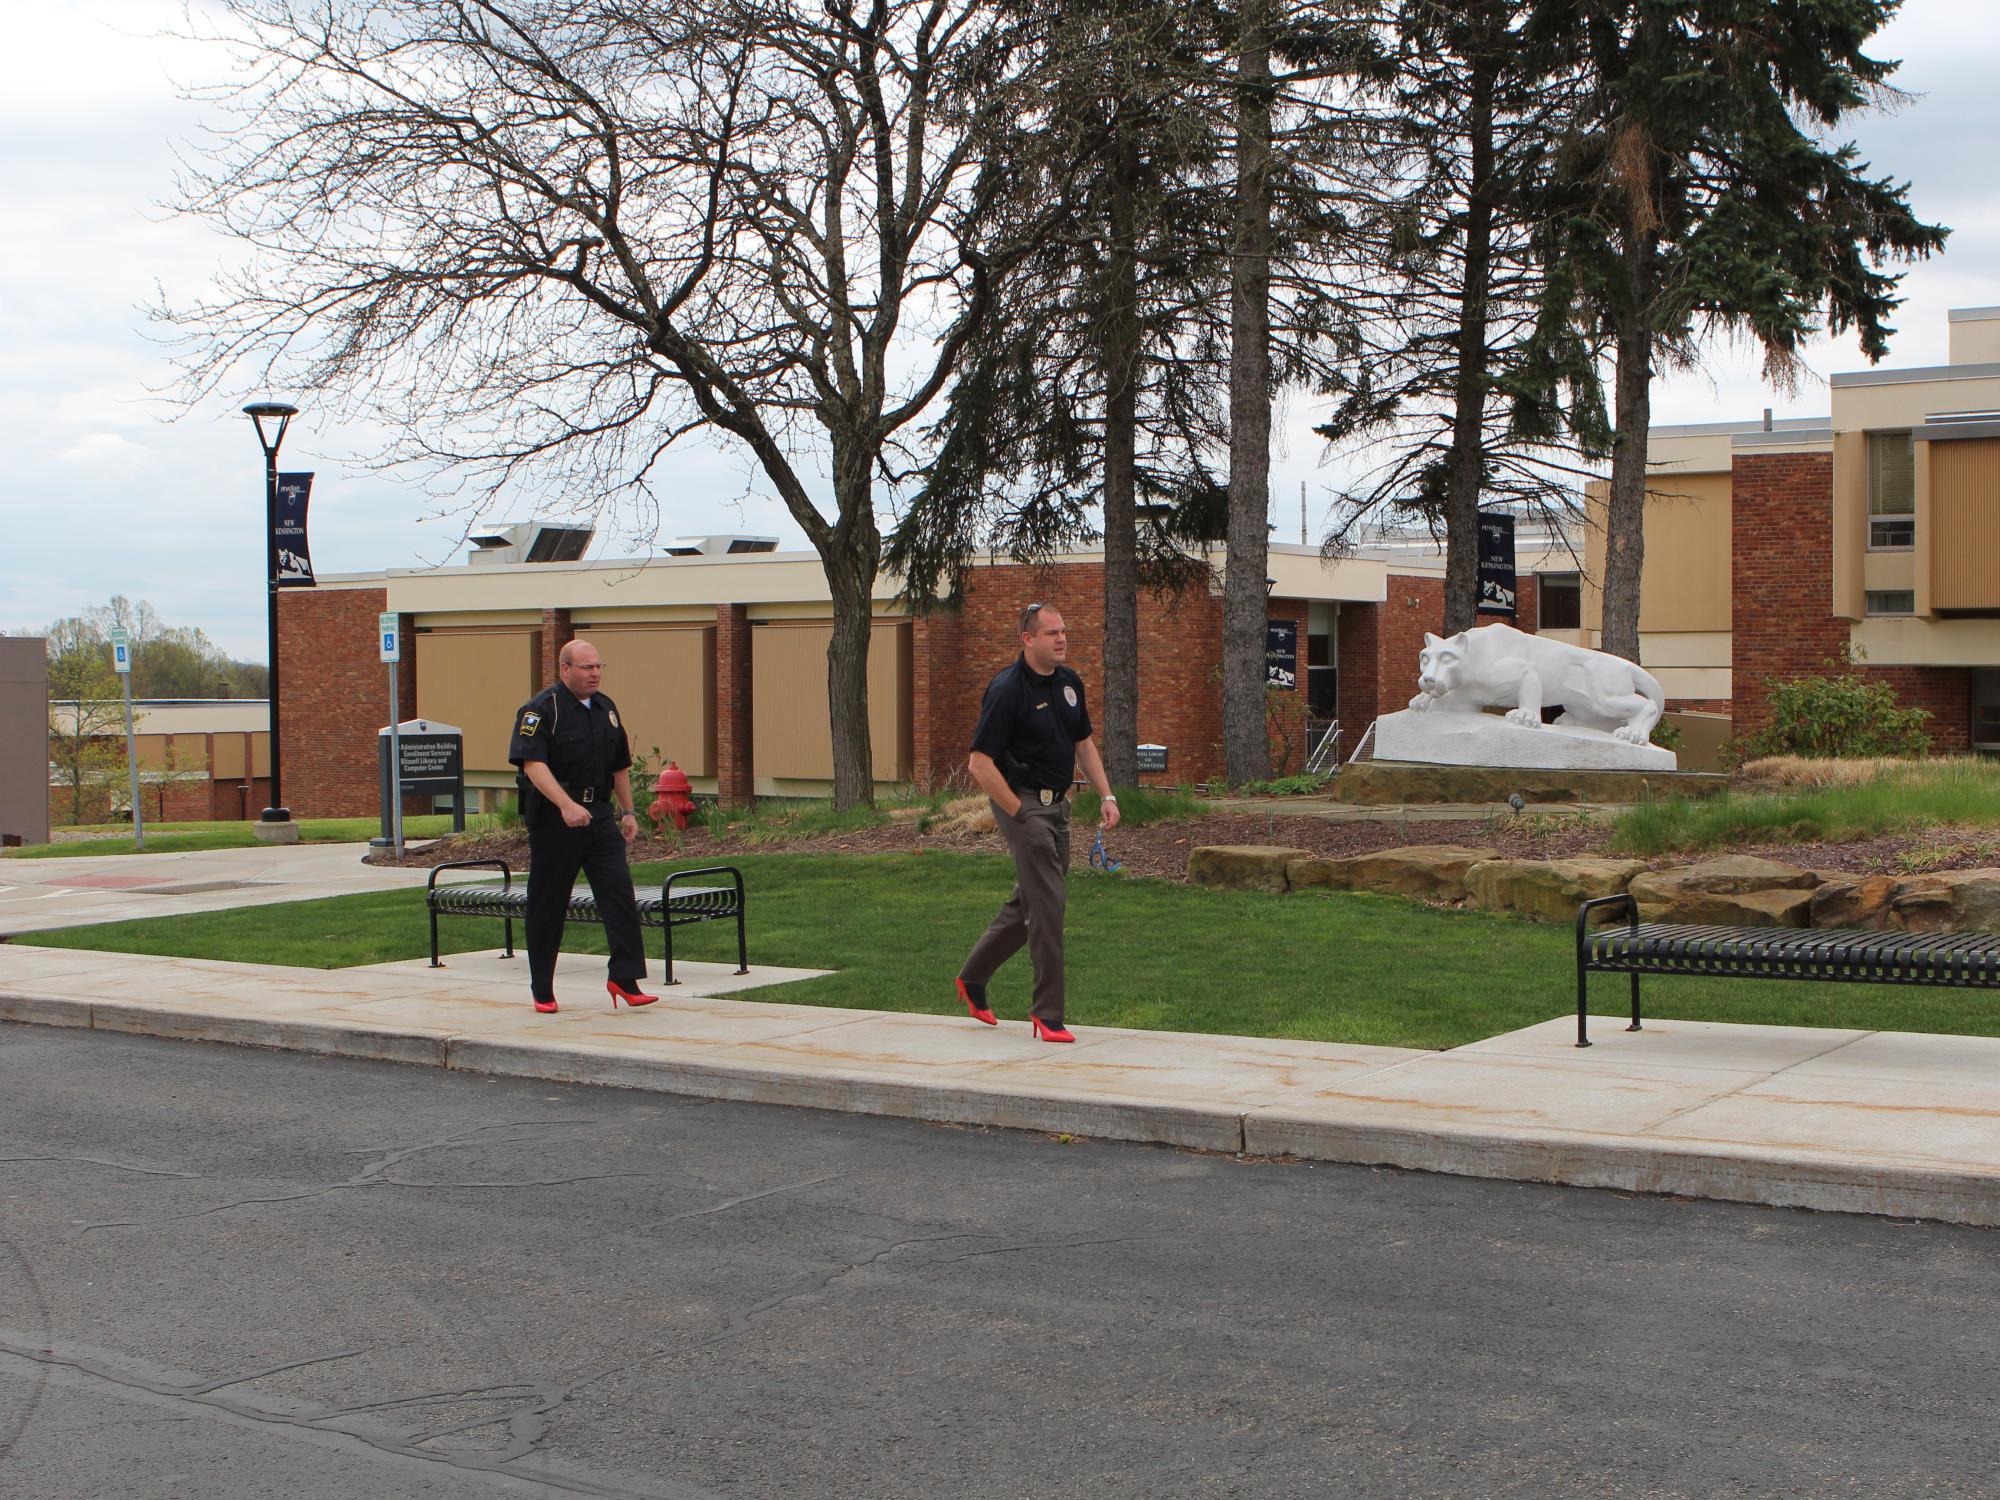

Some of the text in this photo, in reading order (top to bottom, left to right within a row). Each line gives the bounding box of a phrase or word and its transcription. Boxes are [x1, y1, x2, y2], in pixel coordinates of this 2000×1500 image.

[284, 519, 296, 527] NEW
[1481, 561, 1514, 570] KENSINGTON
[436, 742, 457, 751] Building
[431, 749, 452, 757] Services
[420, 757, 437, 765] Library
[403, 764, 427, 772] Computer
